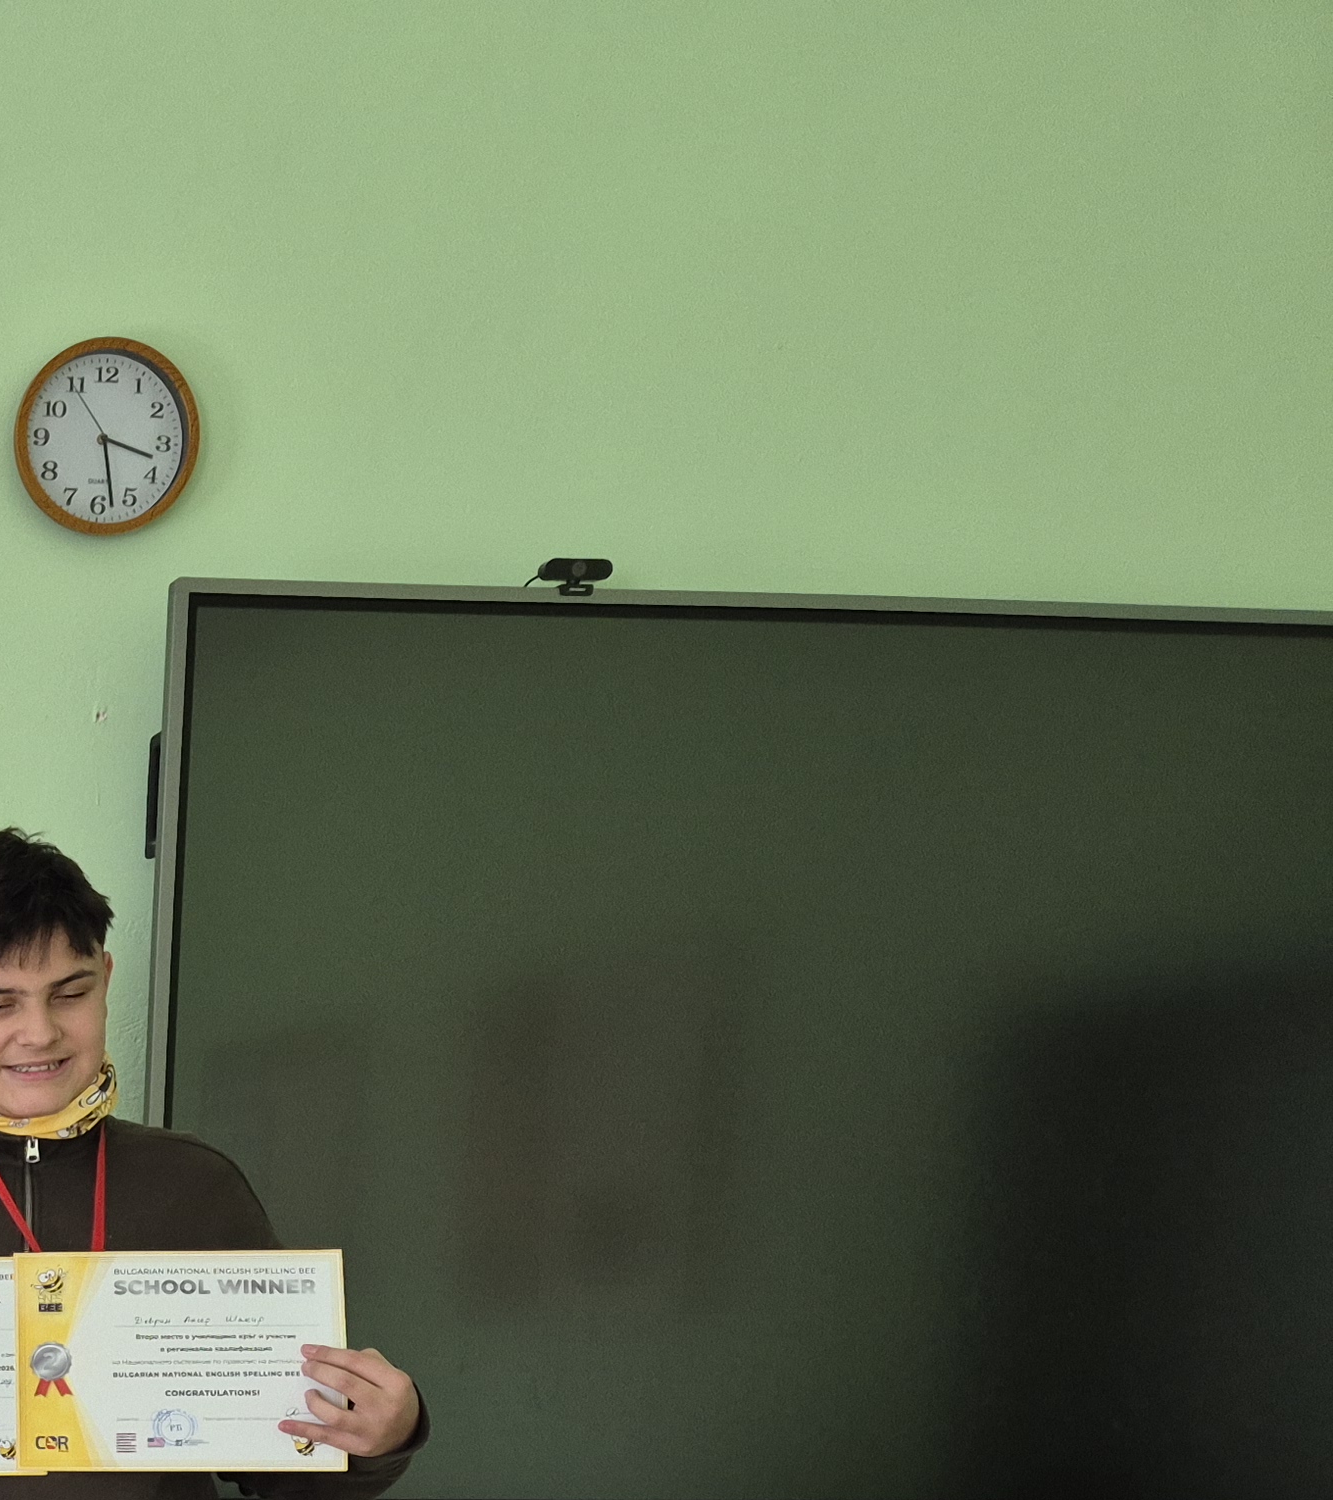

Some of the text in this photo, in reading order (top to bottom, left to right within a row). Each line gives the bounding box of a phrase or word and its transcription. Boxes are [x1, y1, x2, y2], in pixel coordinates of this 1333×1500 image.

[94, 366, 119, 384] 12
[66, 376, 87, 393] 11
[134, 377, 143, 394] 1
[44, 400, 67, 418] 10
[150, 401, 164, 419] 2
[33, 427, 50, 446] 9
[155, 435, 171, 452] 3
[40, 460, 58, 481] 8
[143, 465, 158, 484] 4
[63, 487, 78, 506] 7
[90, 495, 106, 515] 6
[122, 487, 138, 507] 5
[113, 1277, 315, 1295] SCHOOL WINNER
[38, 1303, 63, 1312] BEE
